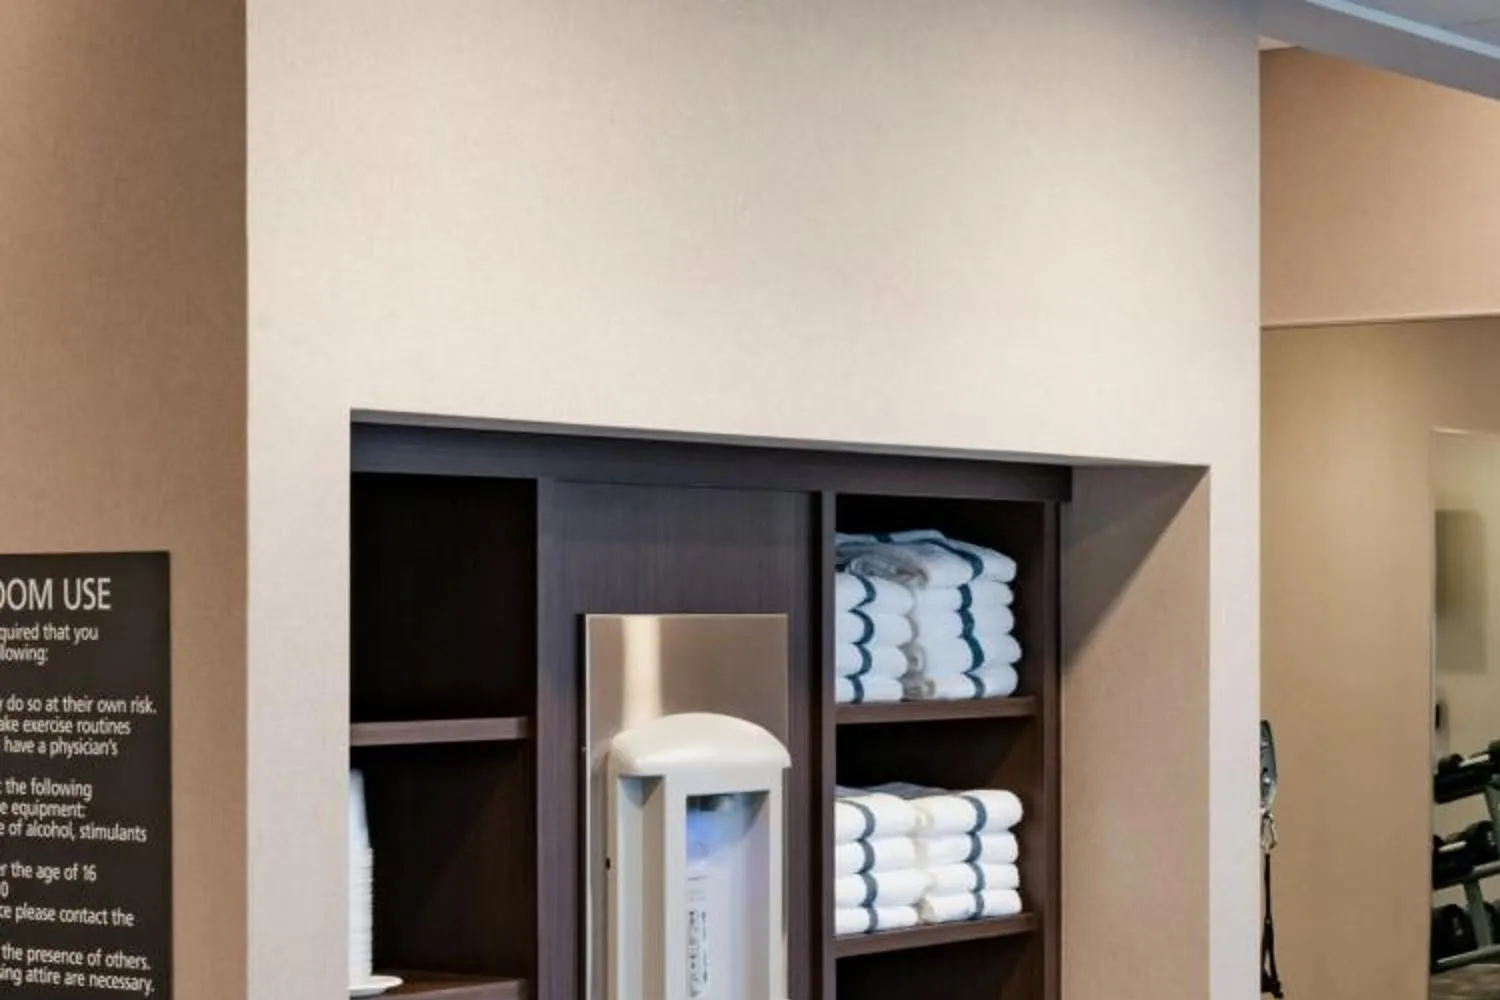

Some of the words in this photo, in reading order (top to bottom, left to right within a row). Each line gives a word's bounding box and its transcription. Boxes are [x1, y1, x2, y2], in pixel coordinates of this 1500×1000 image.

[63, 577, 112, 610] USE
[43, 625, 70, 641] that
[74, 627, 99, 645] you
[7, 694, 24, 712] do
[27, 698, 41, 712] so
[45, 697, 59, 713] at
[63, 695, 92, 713] their
[97, 699, 126, 713] own
[23, 716, 73, 734] exercise
[77, 717, 131, 736] routines
[4, 736, 34, 753] have
[49, 736, 119, 759] physician's
[5, 777, 27, 795] the
[30, 777, 93, 801] following
[8, 818, 22, 837] of
[79, 823, 147, 844] stimulants
[11, 860, 33, 879] the
[36, 865, 61, 885] age
[64, 862, 78, 881] of
[15, 902, 56, 924] please
[60, 907, 109, 926] contact
[112, 907, 136, 928] the
[1, 942, 23, 961] the
[27, 947, 84, 967] presence
[87, 948, 102, 967] of
[105, 950, 152, 972] others.
[25, 966, 61, 985] attire
[64, 971, 86, 987] are
[89, 975, 156, 998] necessary.
